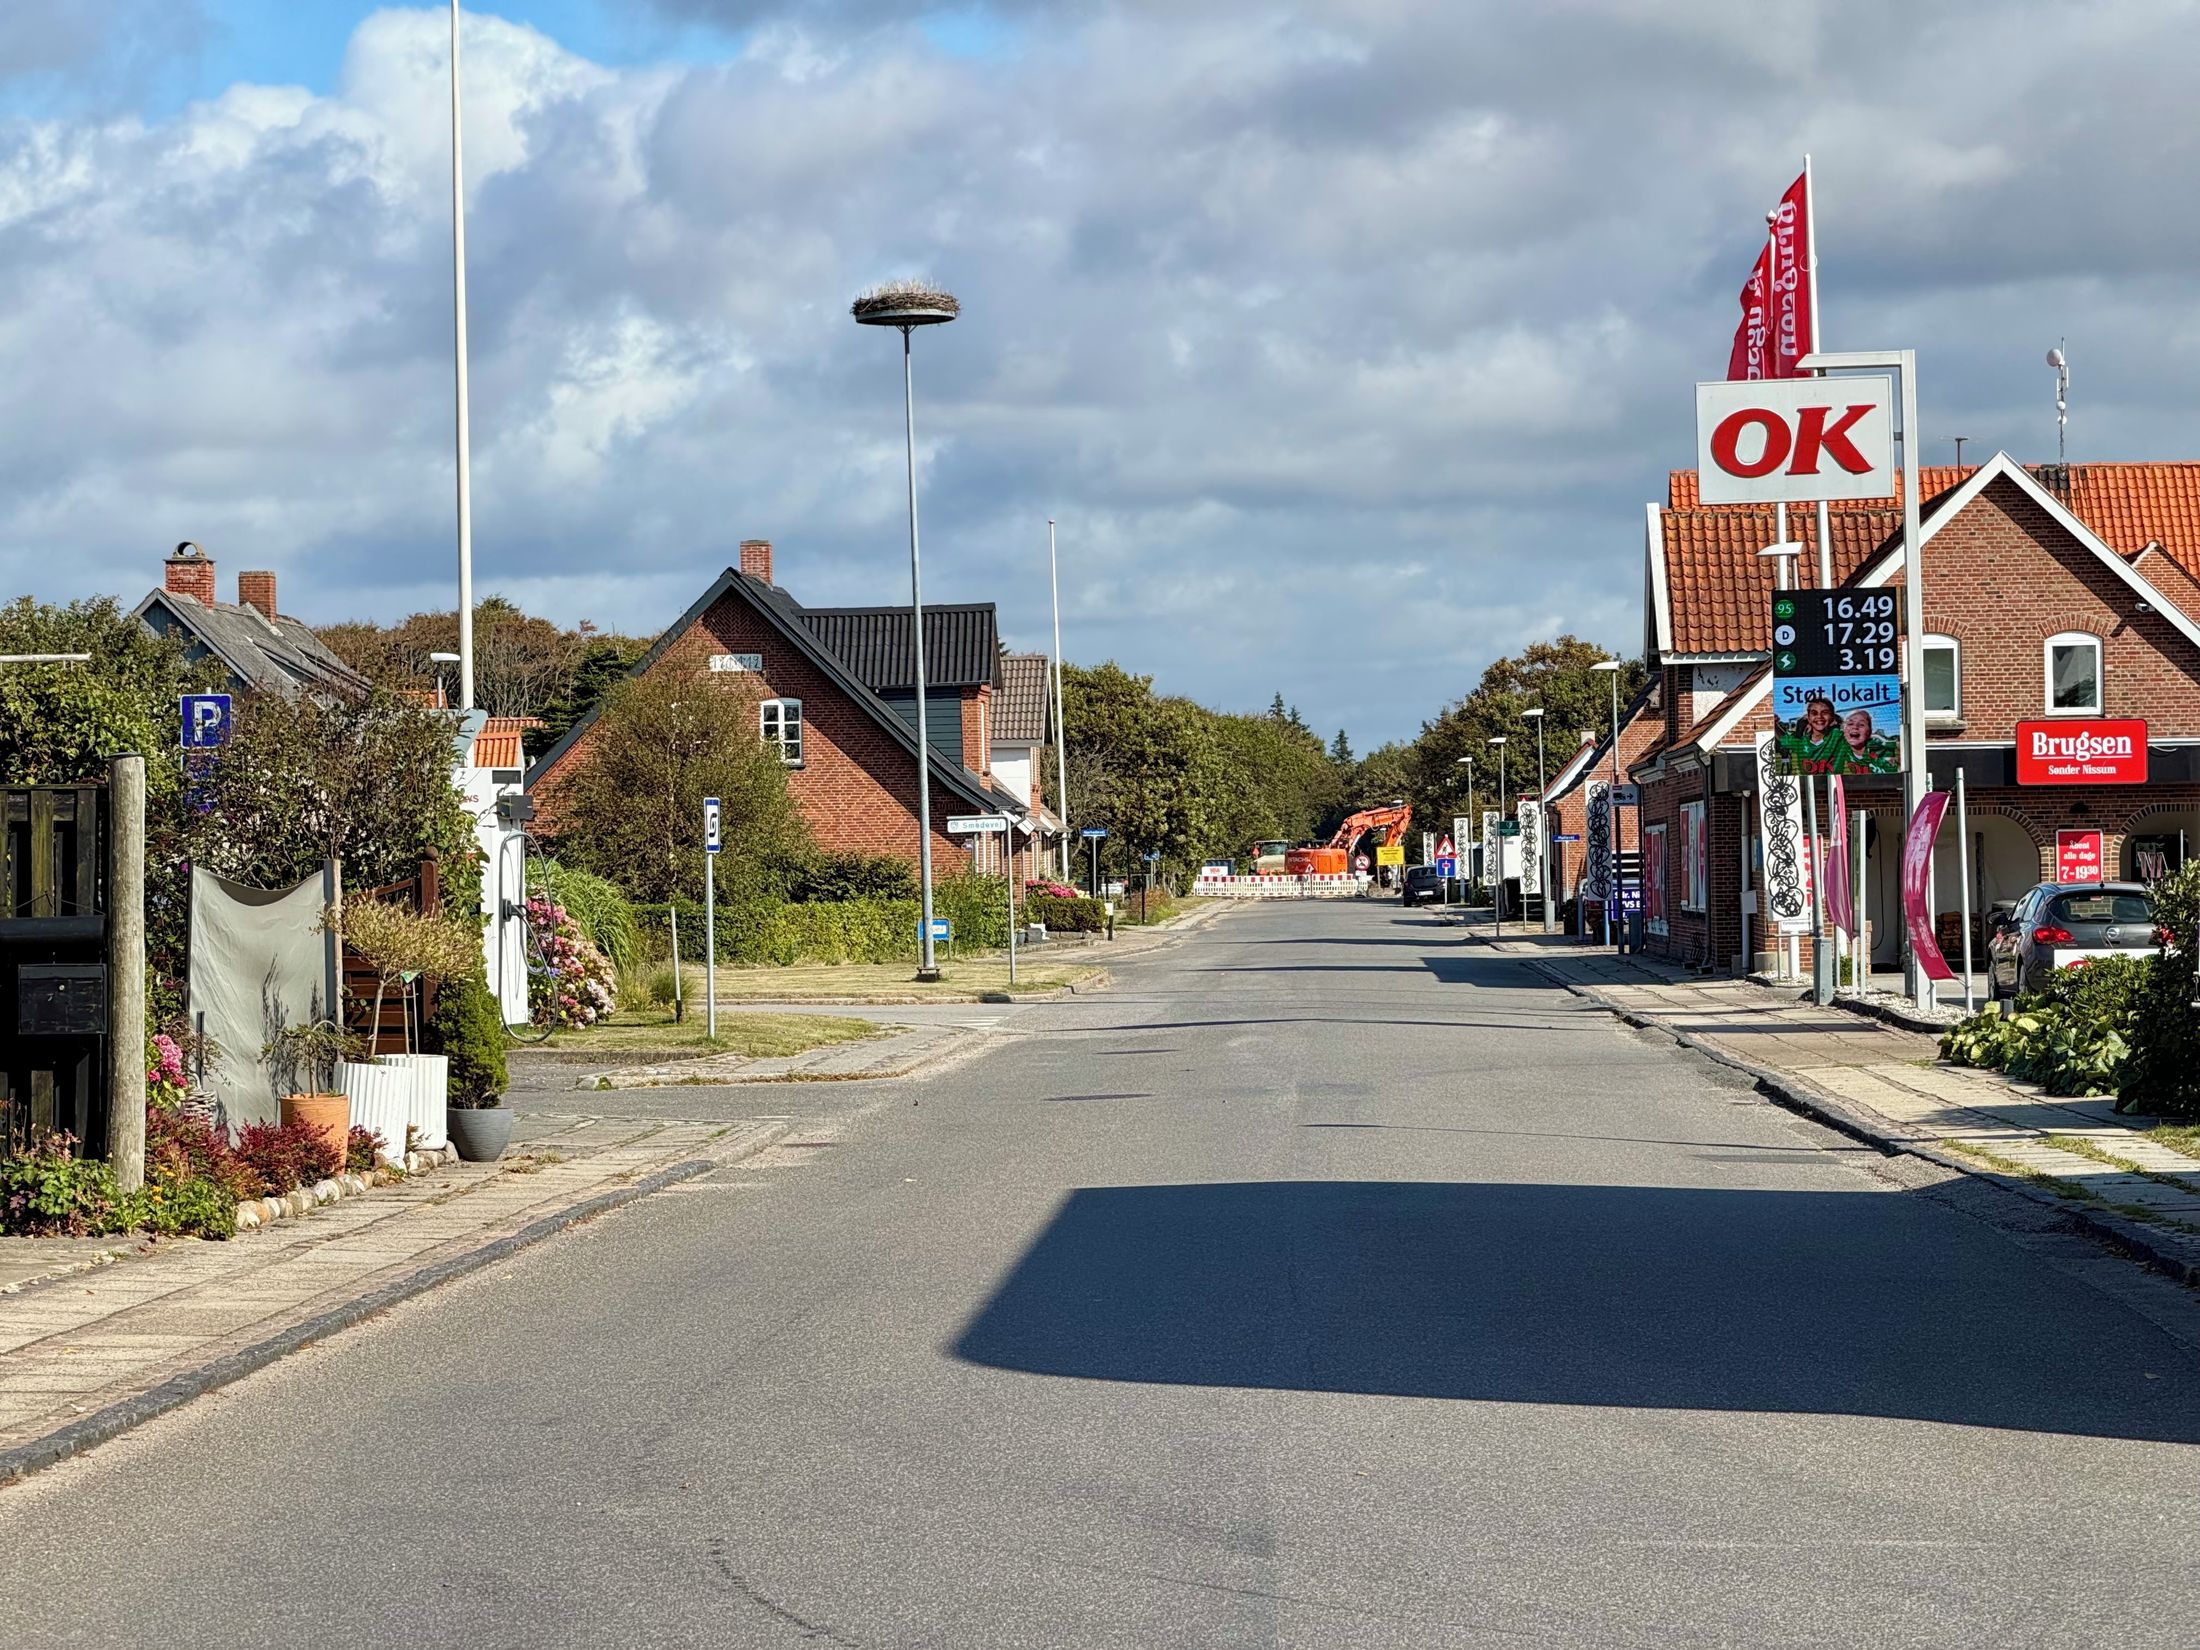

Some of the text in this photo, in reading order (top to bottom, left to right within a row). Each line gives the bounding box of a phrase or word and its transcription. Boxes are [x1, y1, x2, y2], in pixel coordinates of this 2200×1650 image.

[1711, 404, 1877, 479] OK
[1777, 596, 1894, 619] 95 16.49
[1782, 622, 1894, 645] D 17.29
[1840, 648, 1895, 670] 3.19
[1783, 682, 1891, 704] Støt lokalt
[194, 701, 221, 741] P
[2032, 731, 2132, 761] Brugsen
[2048, 764, 2116, 775] Sønder Nissum
[2064, 852, 2096, 861] alle dage
